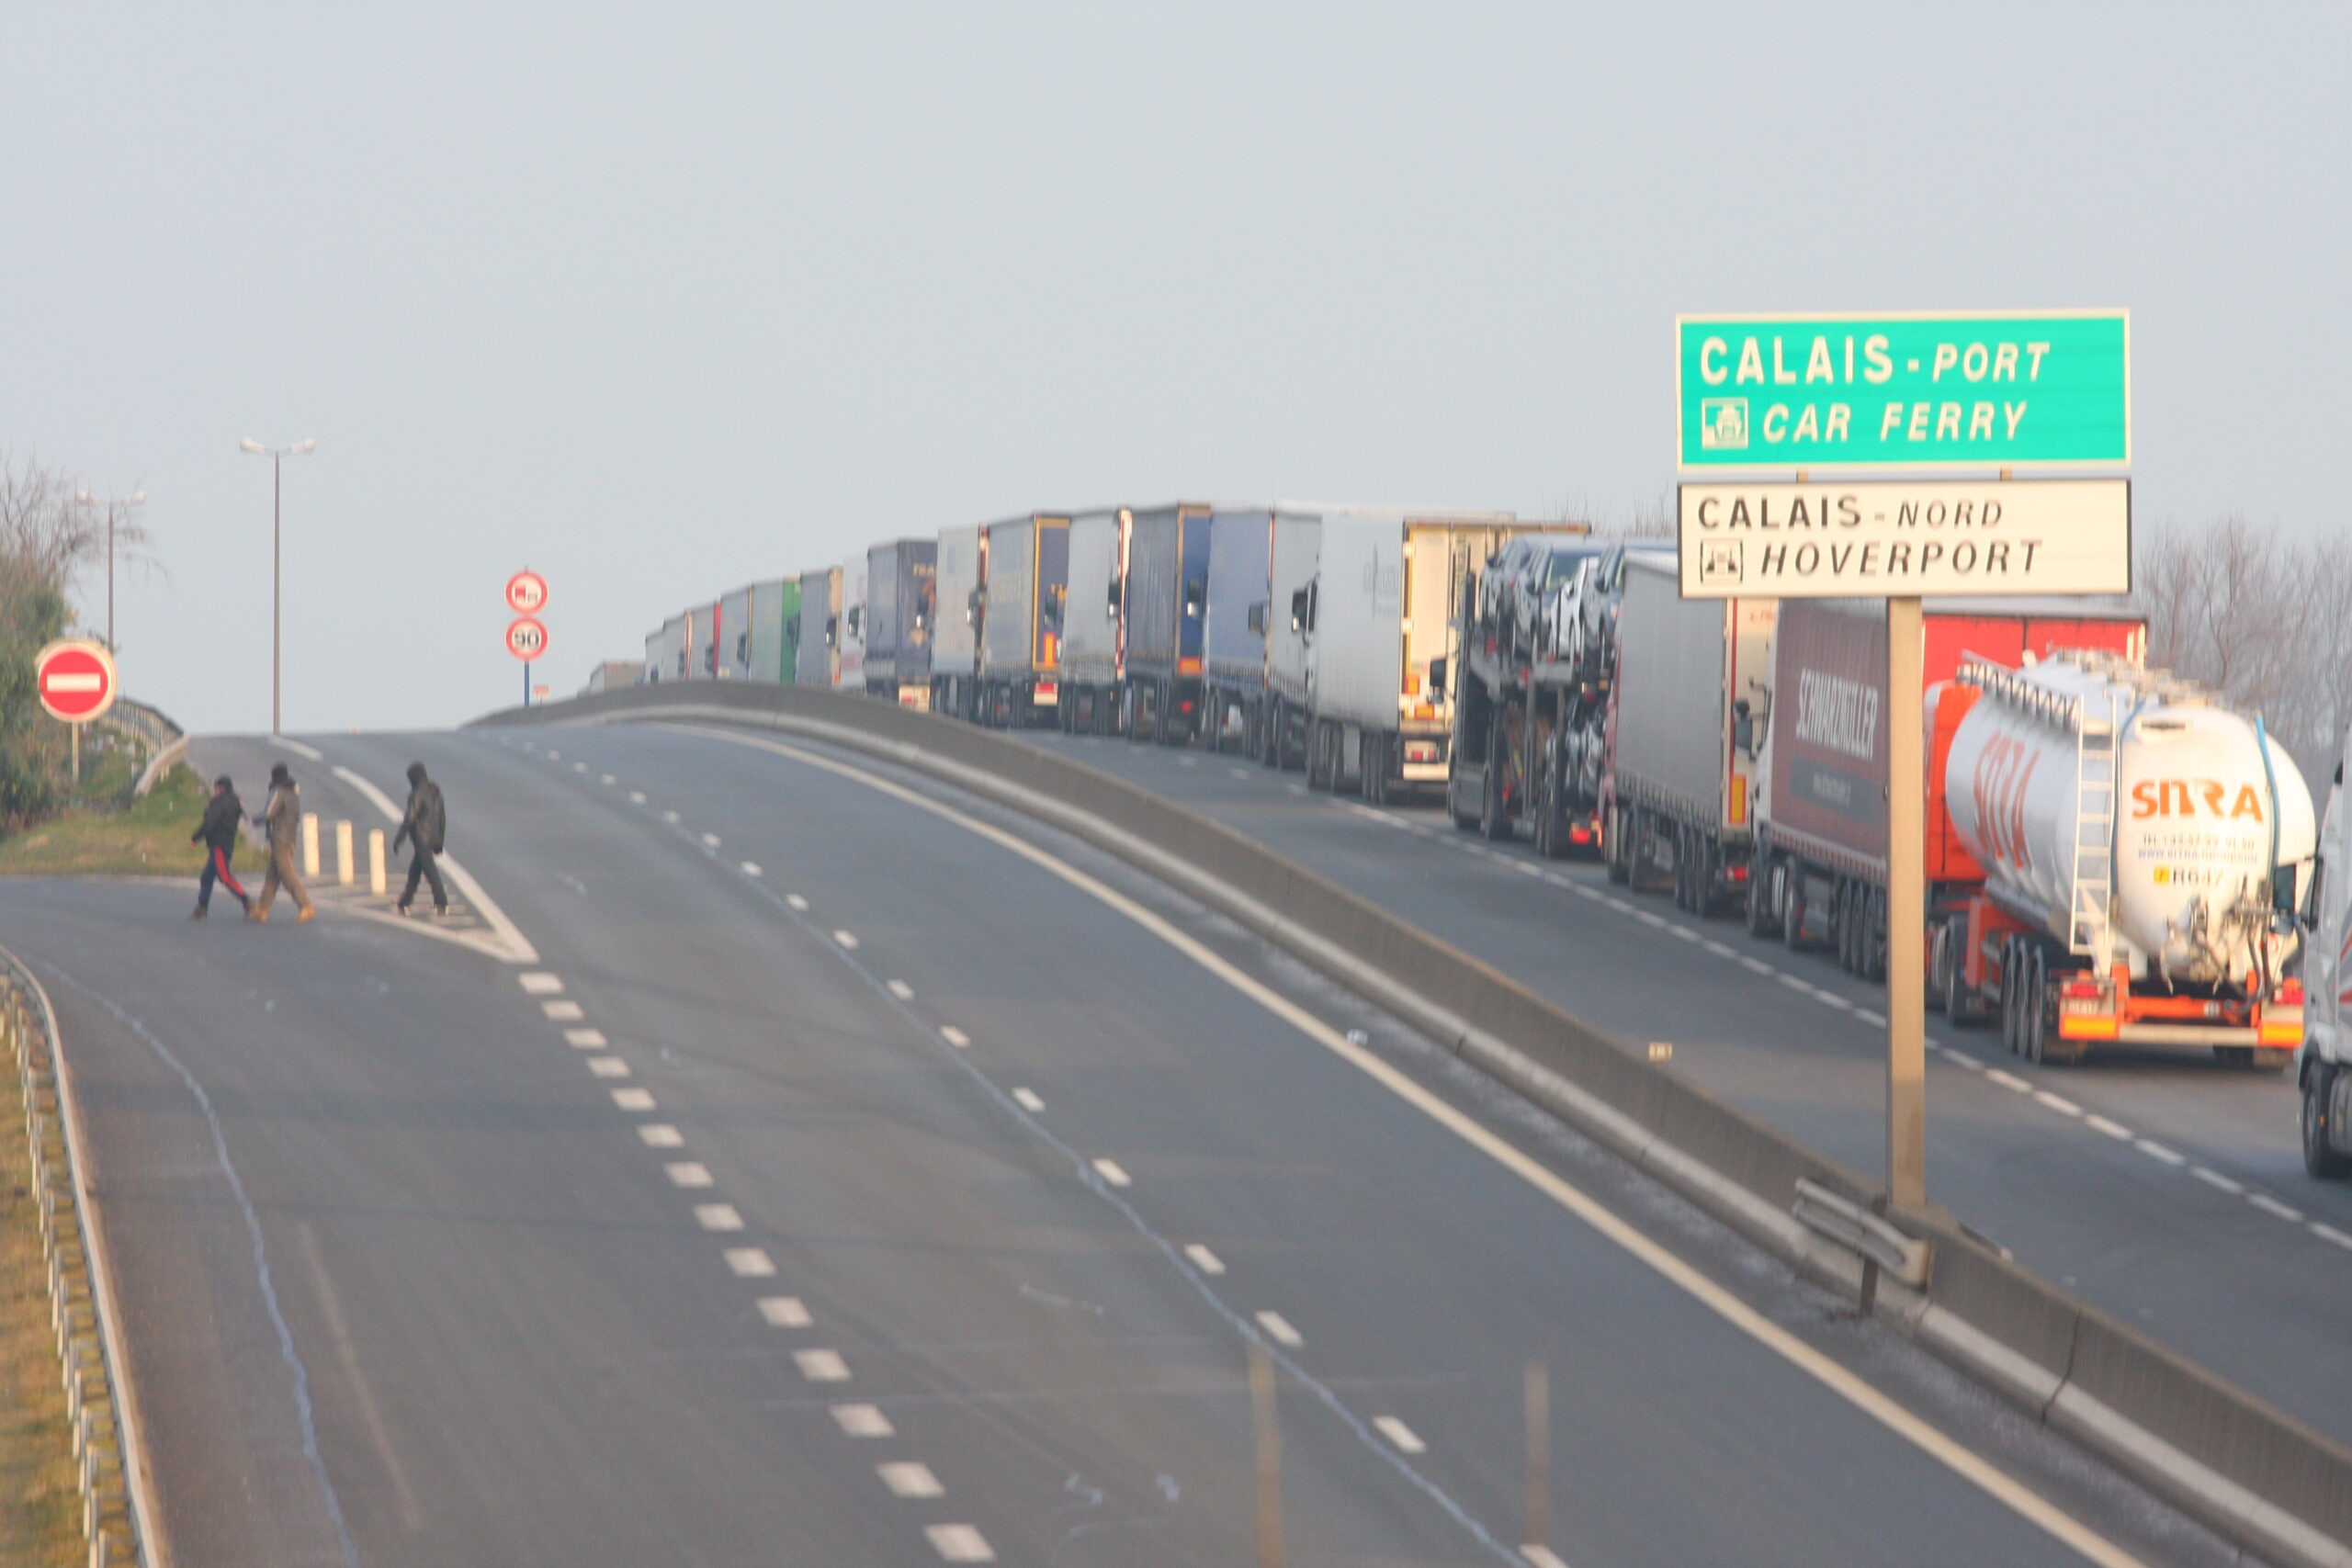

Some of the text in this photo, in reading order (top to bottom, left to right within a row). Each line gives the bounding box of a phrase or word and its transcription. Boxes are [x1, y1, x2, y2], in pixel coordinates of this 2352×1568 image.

[1762, 400, 2028, 443] CAR FERRY
[1759, 538, 2043, 576] HOVERPORT
[514, 627, 540, 650] 90
[2132, 778, 2264, 823] SITRA
